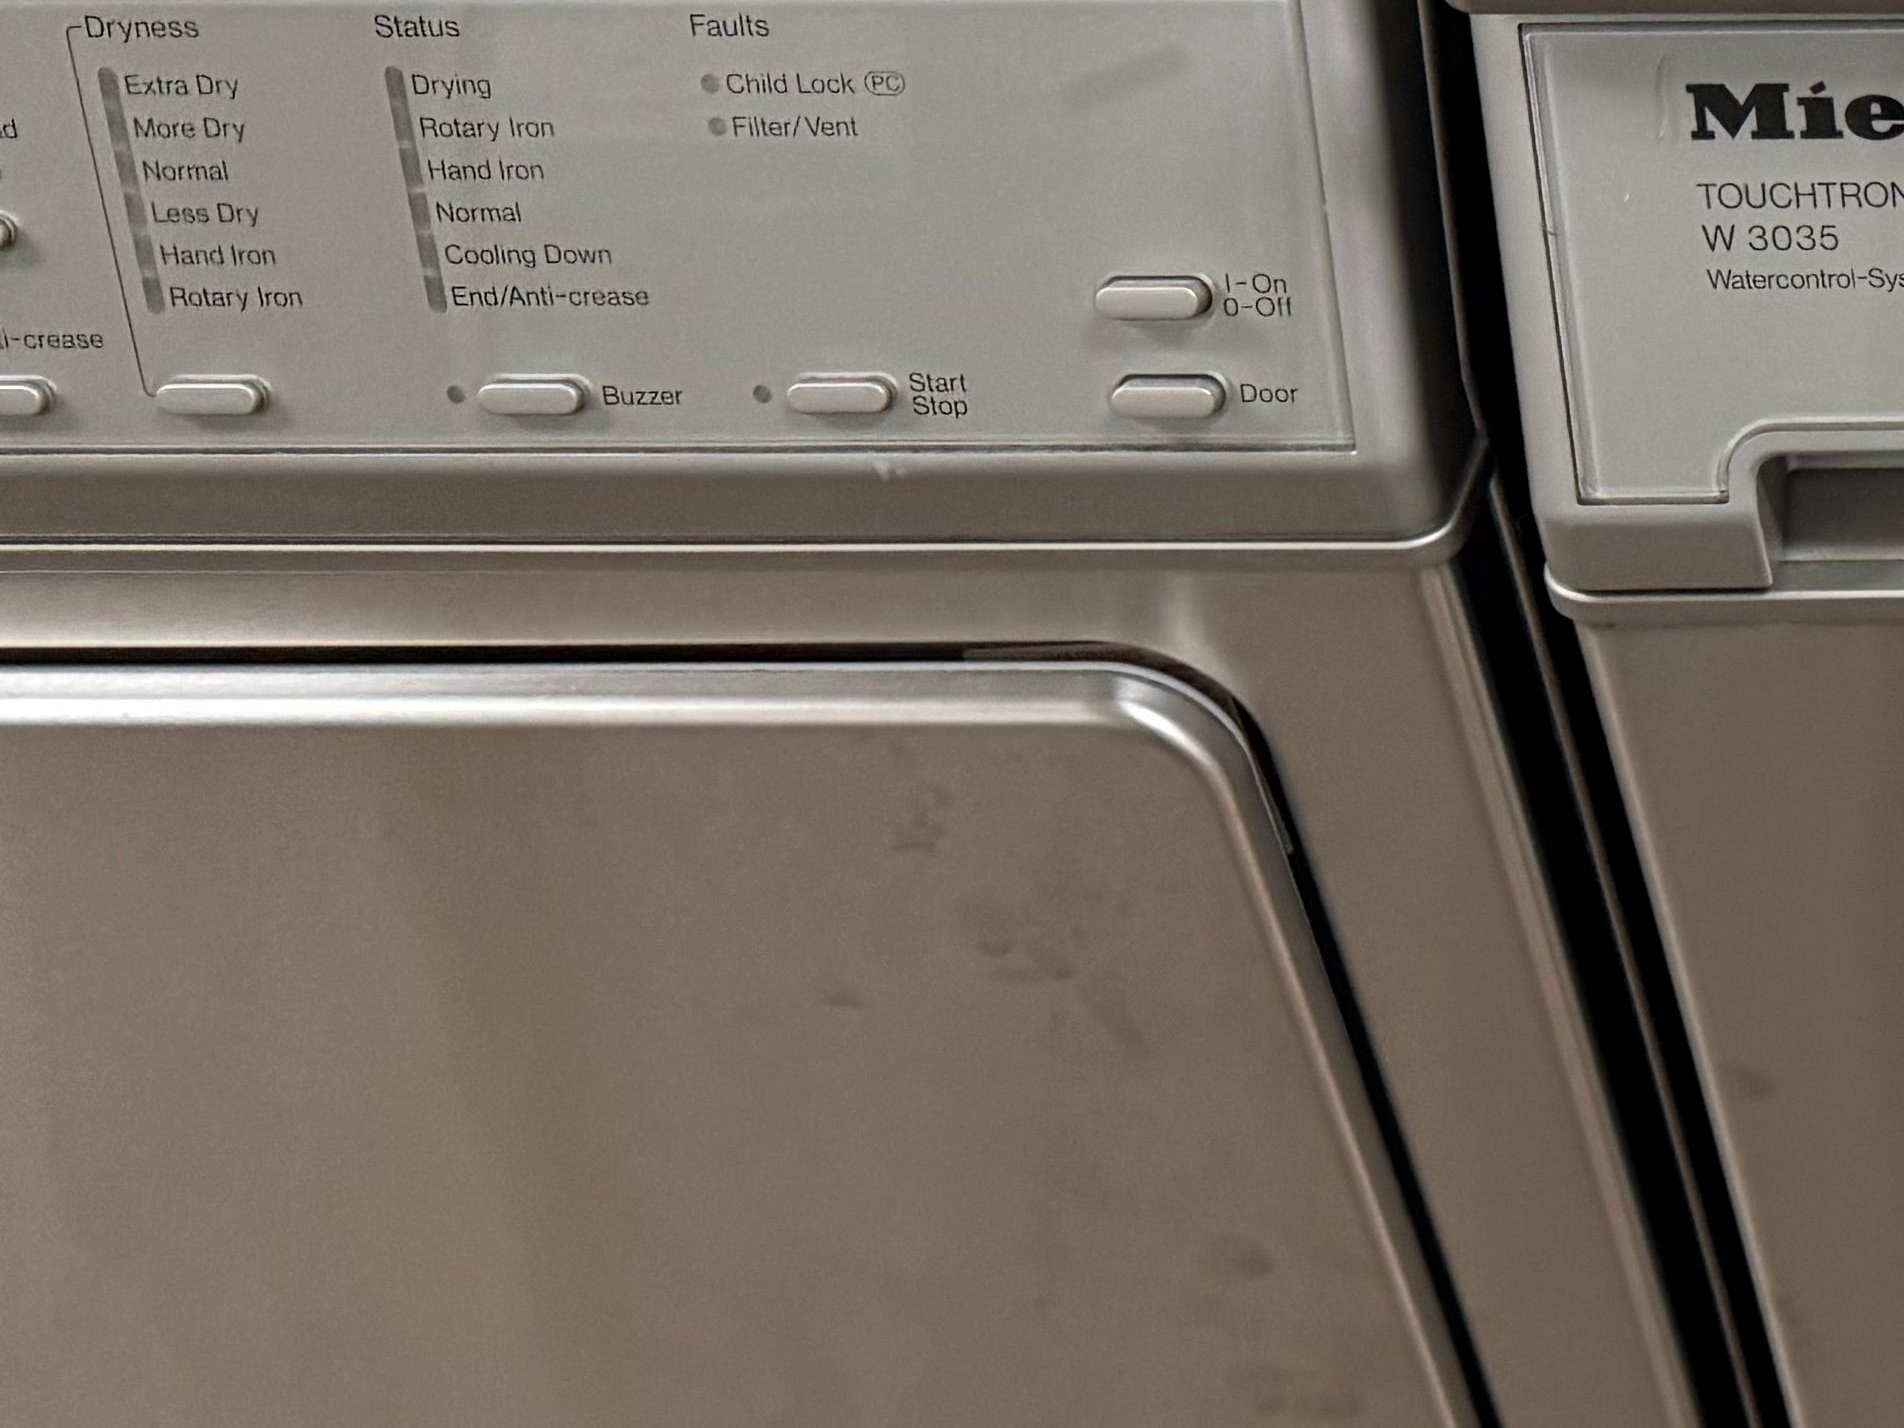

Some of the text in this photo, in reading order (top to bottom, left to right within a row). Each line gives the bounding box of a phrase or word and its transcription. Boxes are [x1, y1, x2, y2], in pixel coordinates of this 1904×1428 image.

[84, 16, 199, 43] Dryness
[374, 15, 460, 39] Status
[689, 13, 770, 38] Faults
[125, 75, 239, 100] Extra Dry
[412, 75, 492, 100] Drying
[726, 73, 901, 96] Child Lock PC
[134, 118, 245, 143] More Dry
[420, 117, 555, 143] Rotary Iron
[143, 161, 228, 182] Normal
[428, 160, 545, 182] Hand Iron
[151, 203, 259, 228] Less Dry
[436, 203, 522, 225] Normal
[1701, 224, 1838, 252] W 3035
[160, 244, 276, 267] Hand Iron
[445, 244, 612, 269] Cooling Down
[169, 287, 303, 312] Rotary Iron
[452, 286, 650, 308] End/Anti-crease
[602, 385, 683, 407] Buzzer
[909, 373, 968, 396] Start
[1239, 383, 1298, 404] Door
[912, 396, 969, 418] Stop
